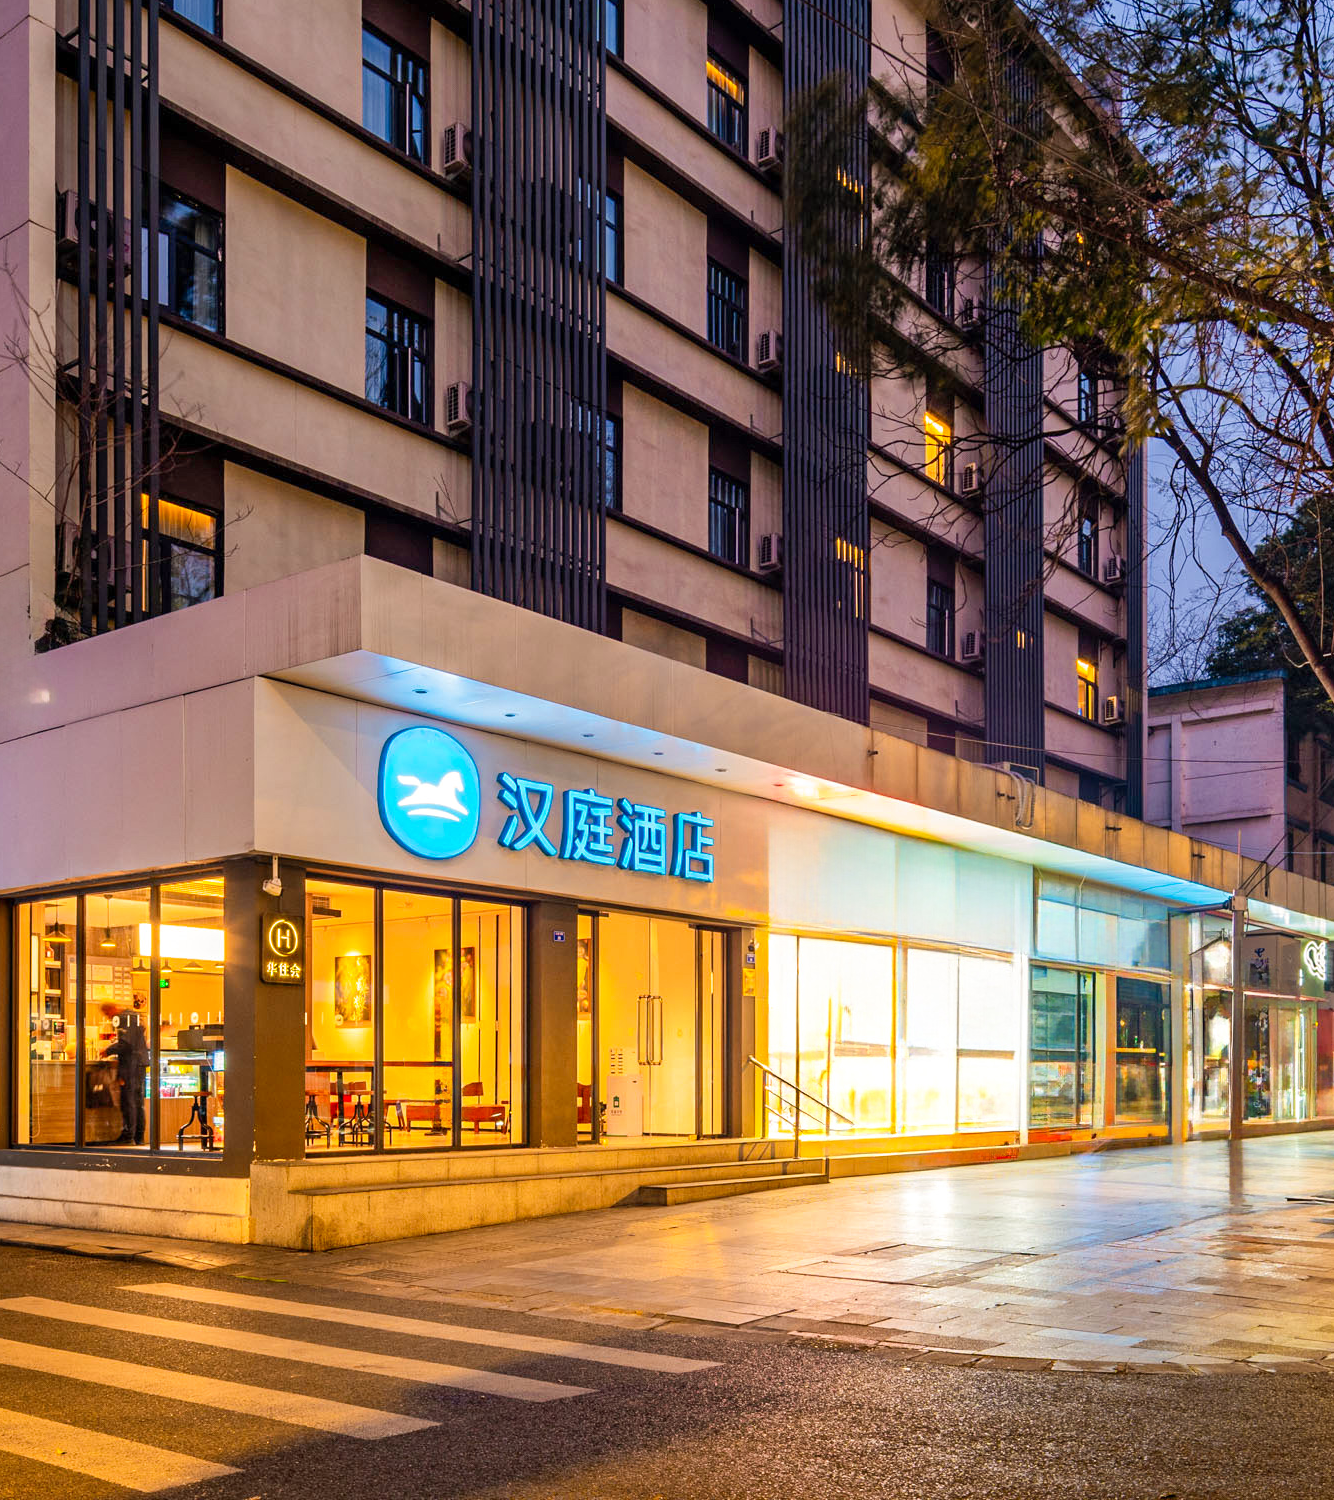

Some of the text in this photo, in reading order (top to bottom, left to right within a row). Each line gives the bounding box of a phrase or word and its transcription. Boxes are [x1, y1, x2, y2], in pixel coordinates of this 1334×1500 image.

[496, 771, 715, 883] 汉庭酒店
[266, 960, 301, 978] 华住会
